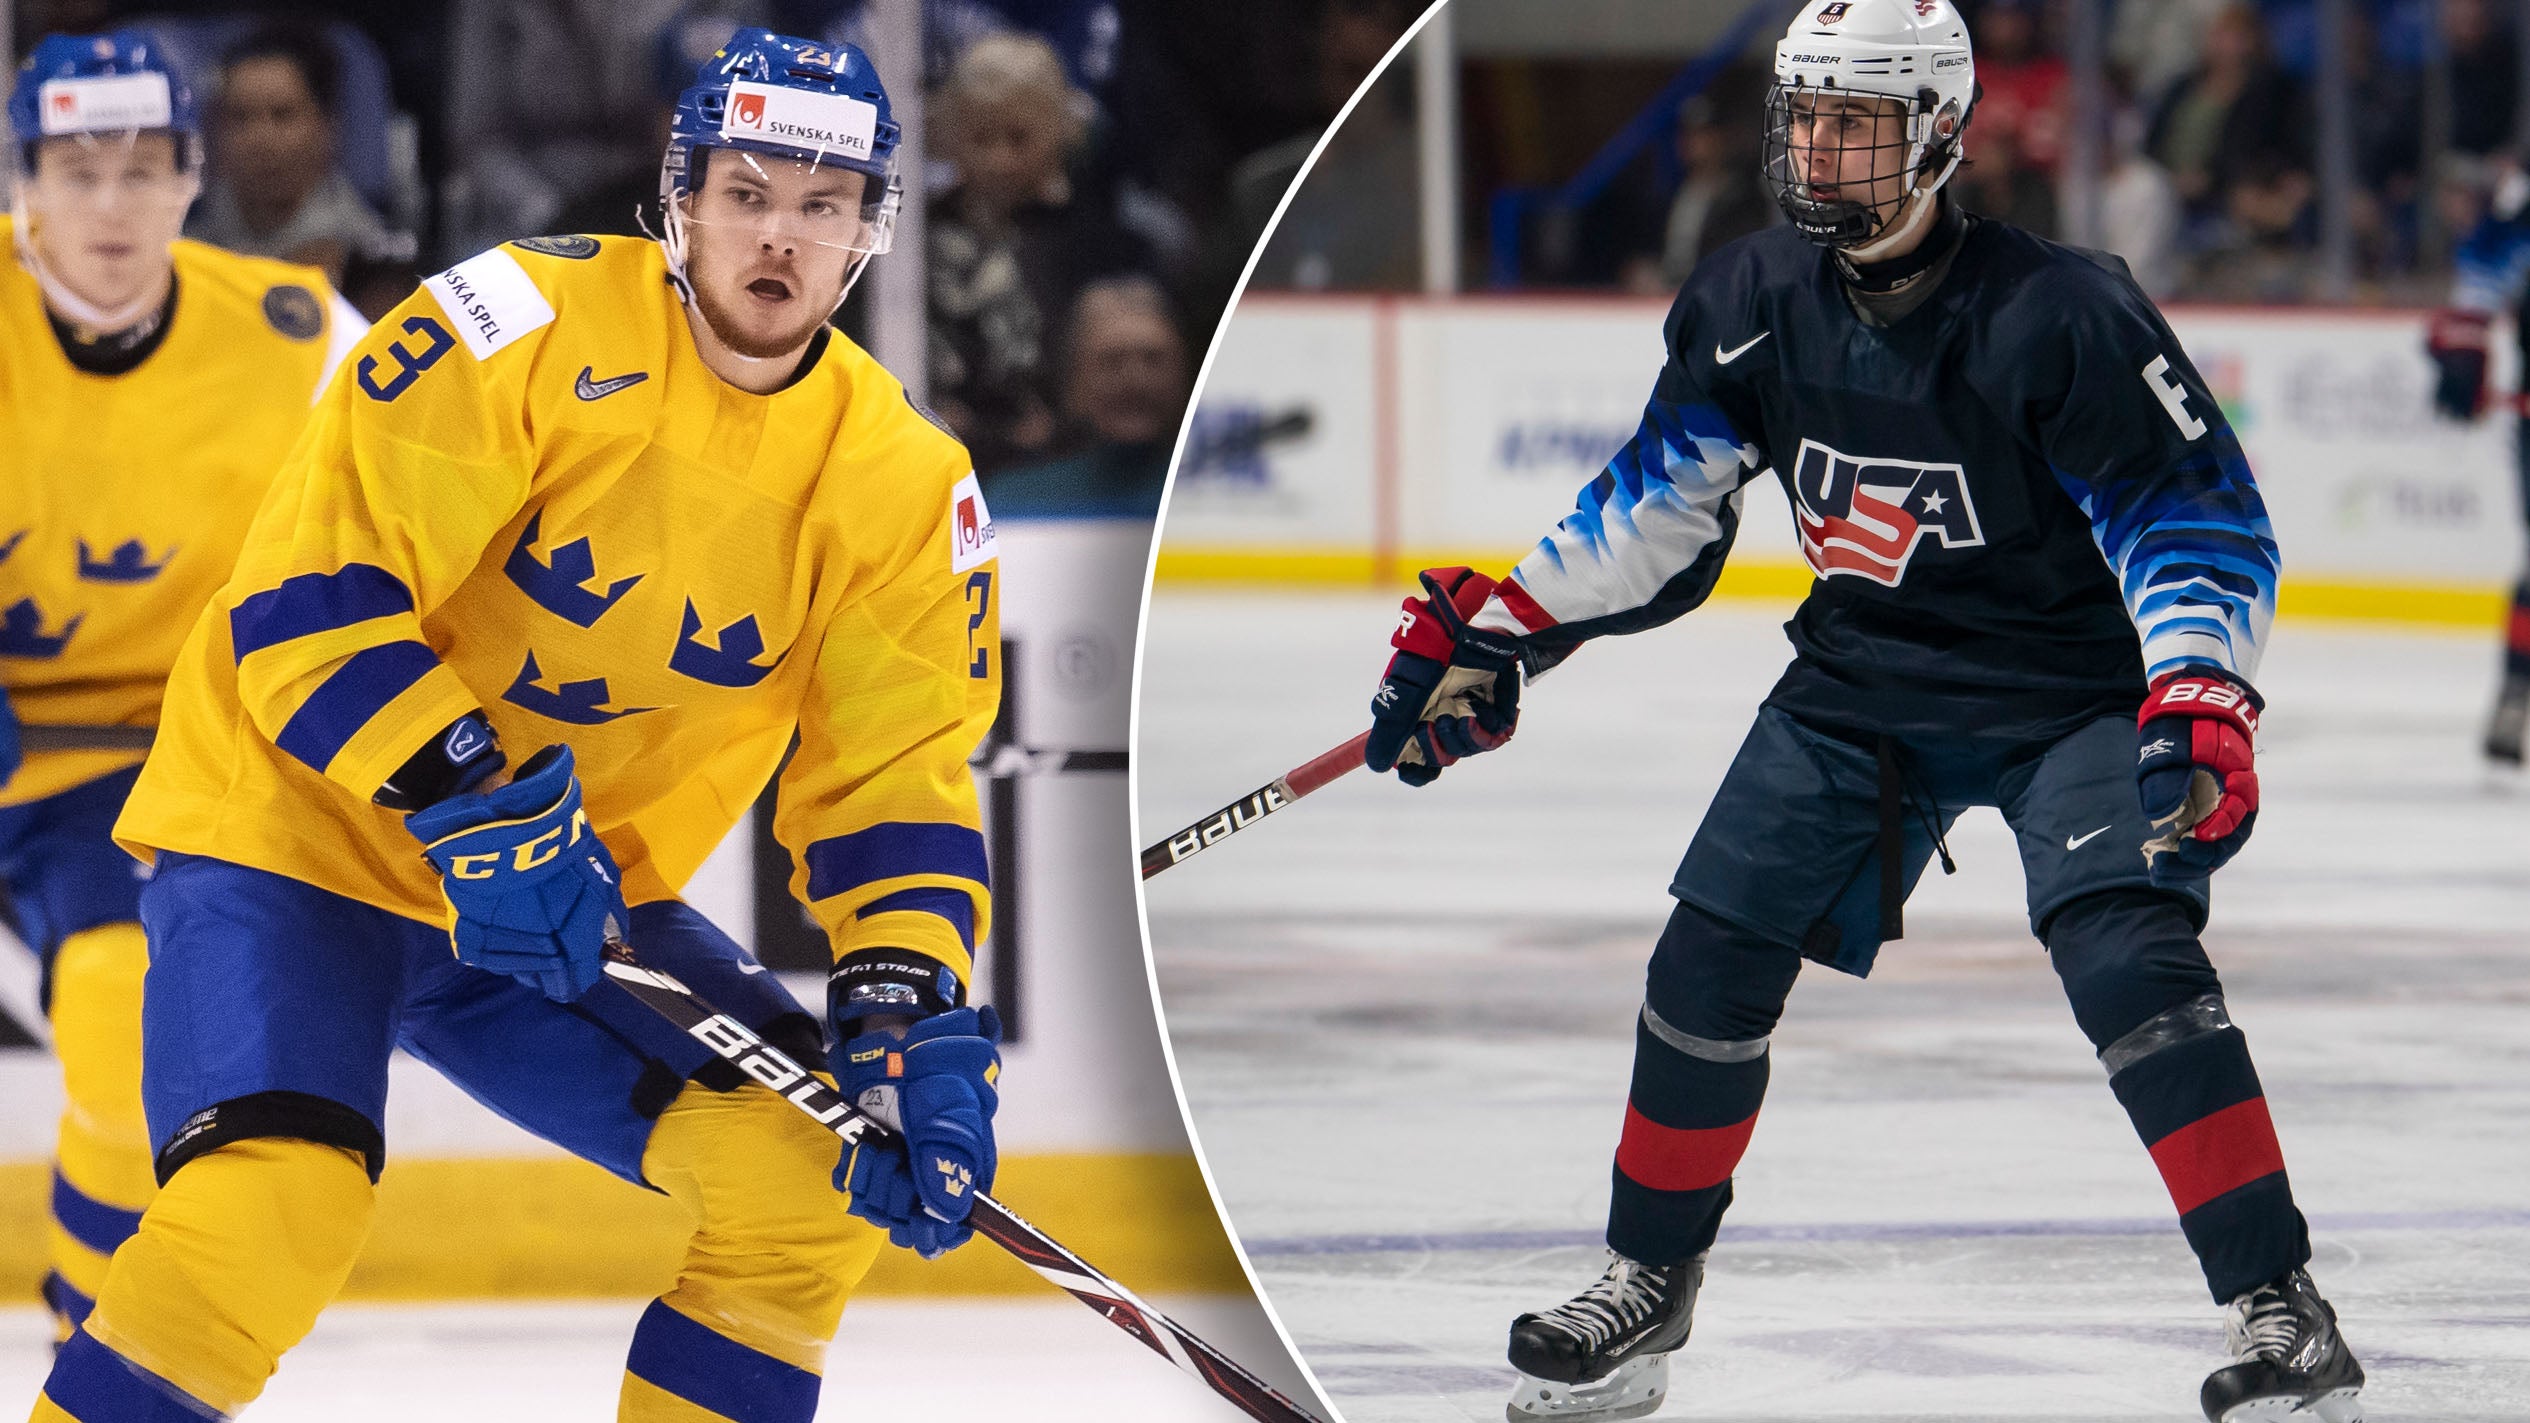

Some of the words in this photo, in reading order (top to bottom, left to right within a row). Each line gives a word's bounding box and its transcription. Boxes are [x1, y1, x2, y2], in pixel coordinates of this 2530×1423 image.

[1792, 54, 1841, 65] BAUER
[769, 121, 833, 143] SVENSKA
[838, 133, 866, 150] SPEL
[468, 304, 501, 343] SPEL
[357, 316, 457, 403] 3
[1794, 437, 1986, 588] USA
[965, 571, 992, 679] 2
[875, 963, 931, 977] STRAP
[850, 1046, 885, 1063] CCM
